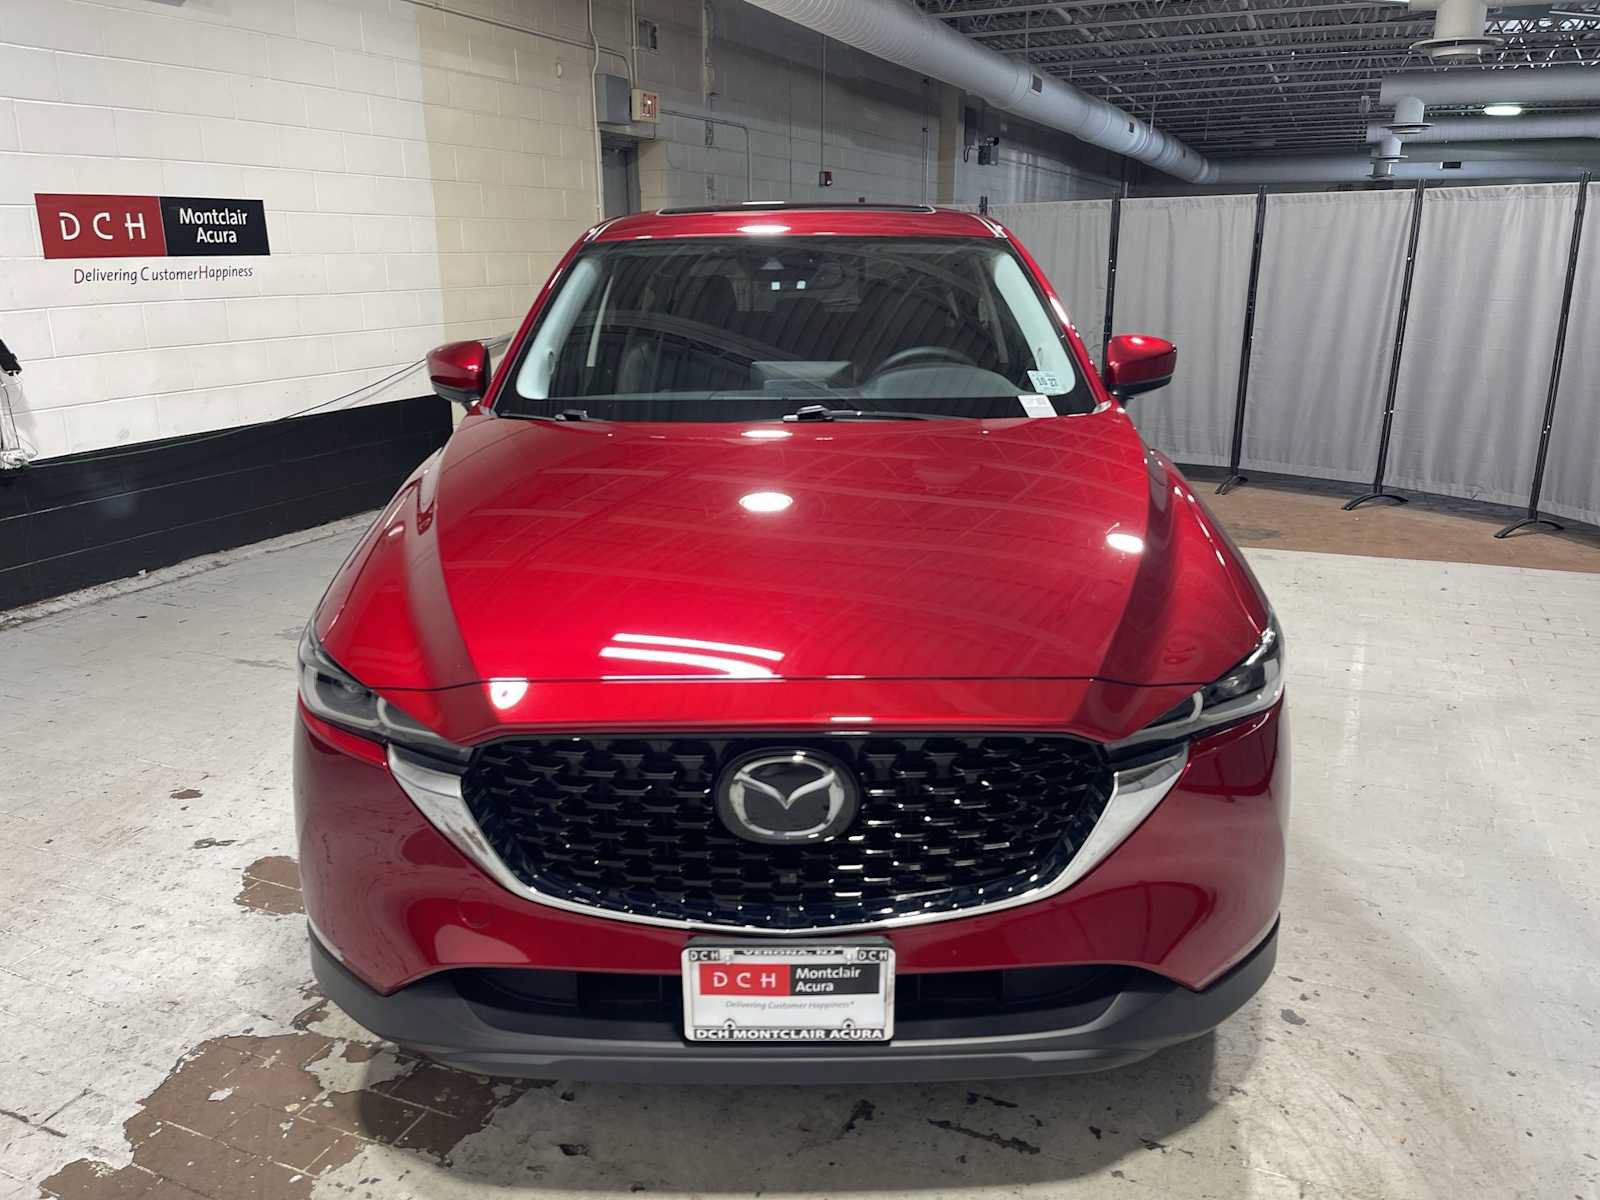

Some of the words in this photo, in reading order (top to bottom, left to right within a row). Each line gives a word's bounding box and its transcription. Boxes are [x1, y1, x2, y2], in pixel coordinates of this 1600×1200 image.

[179, 207, 248, 225] Montclair
[196, 227, 237, 244] Acura
[73, 268, 137, 285] Delivering
[140, 266, 198, 281] Customer
[198, 265, 253, 282] Happiness
[690, 951, 719, 961] DCH
[858, 950, 888, 960] DCH
[795, 966, 862, 979] Montclair
[794, 981, 835, 993] Acura
[725, 1000, 767, 1011] Delivering
[767, 1001, 807, 1010] Customer
[696, 1029, 729, 1040] DCH
[733, 1029, 826, 1040] MONTCLAIR
[828, 1028, 883, 1040] ACURA
